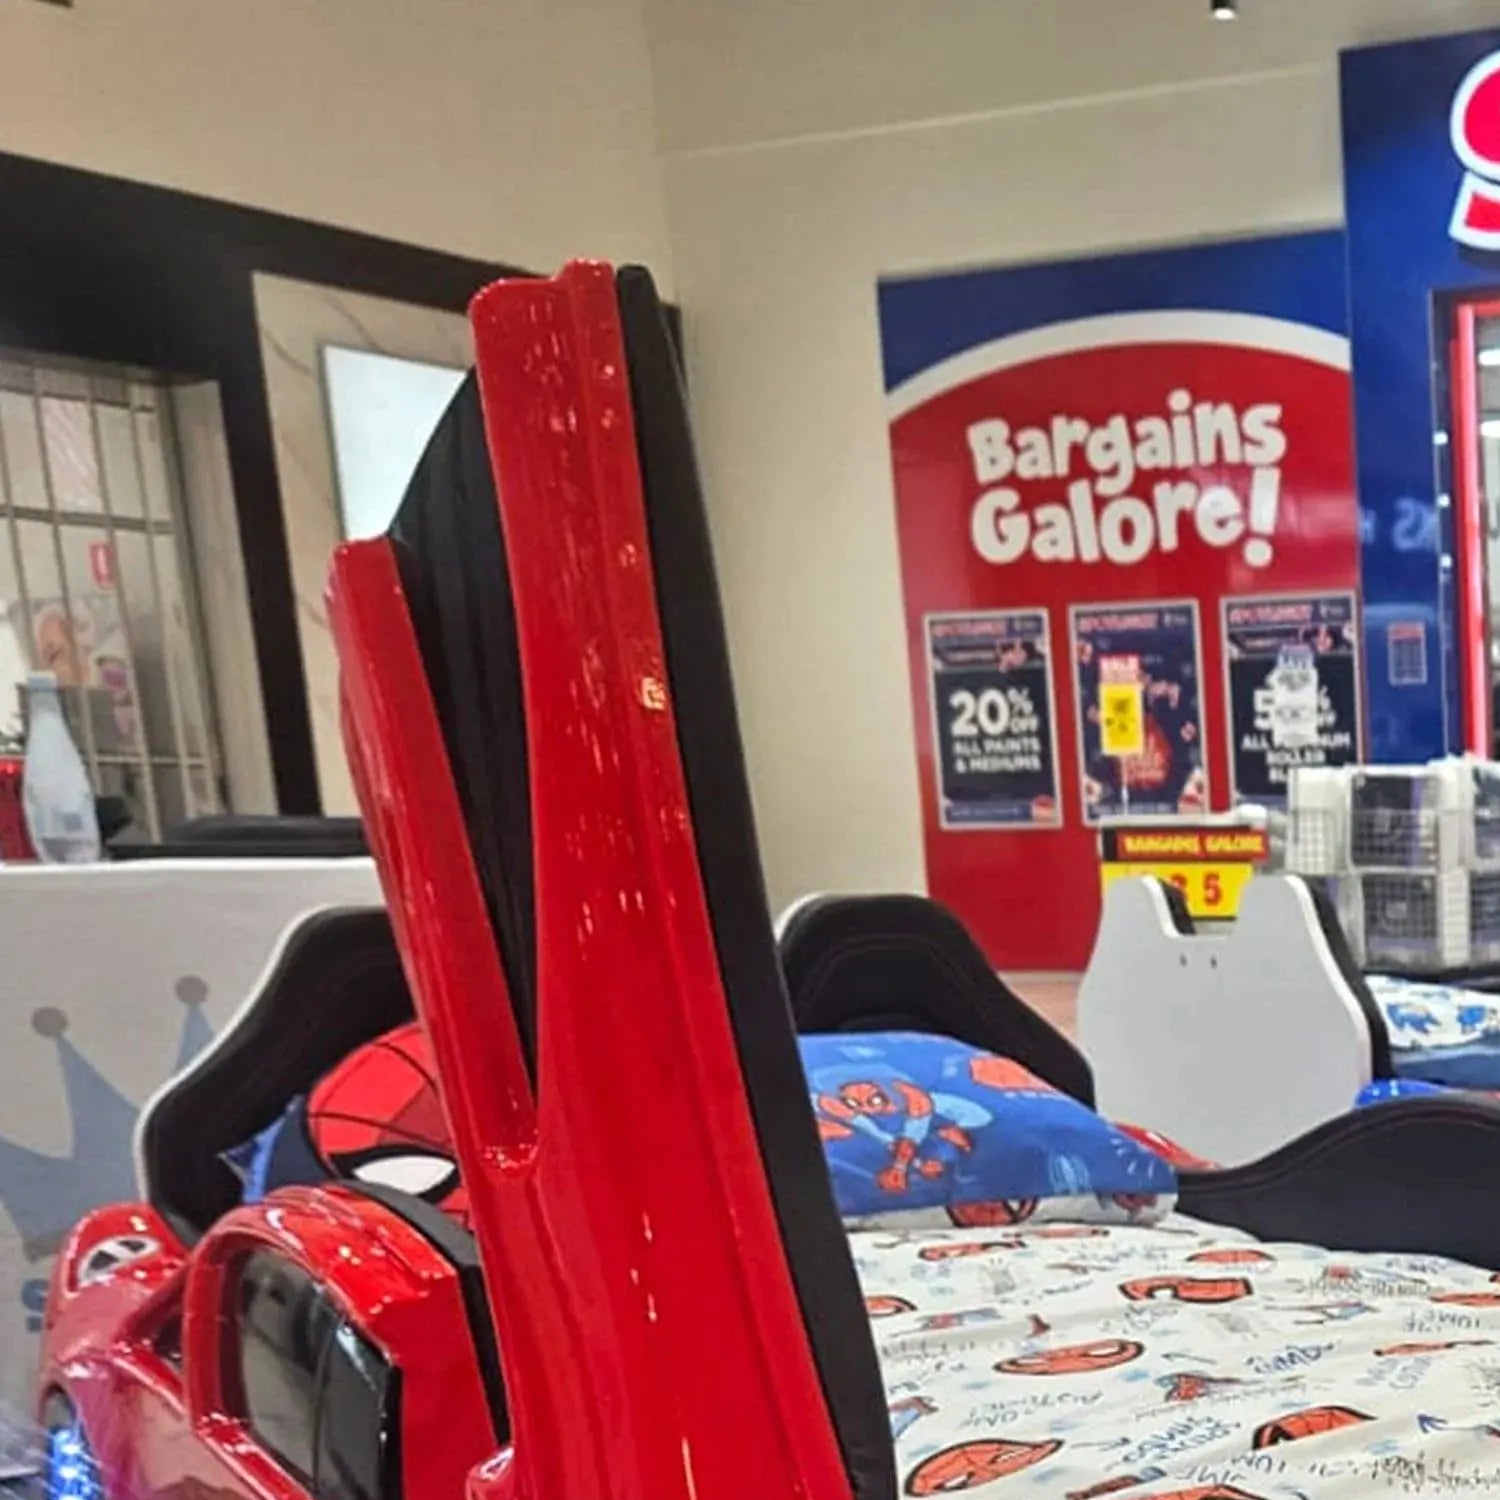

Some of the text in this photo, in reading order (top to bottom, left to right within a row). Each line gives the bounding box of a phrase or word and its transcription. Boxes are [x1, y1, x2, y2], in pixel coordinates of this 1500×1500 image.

[967, 388, 1287, 496] Bargains
[971, 466, 1281, 569] Galore!
[949, 687, 1034, 736] 20%
